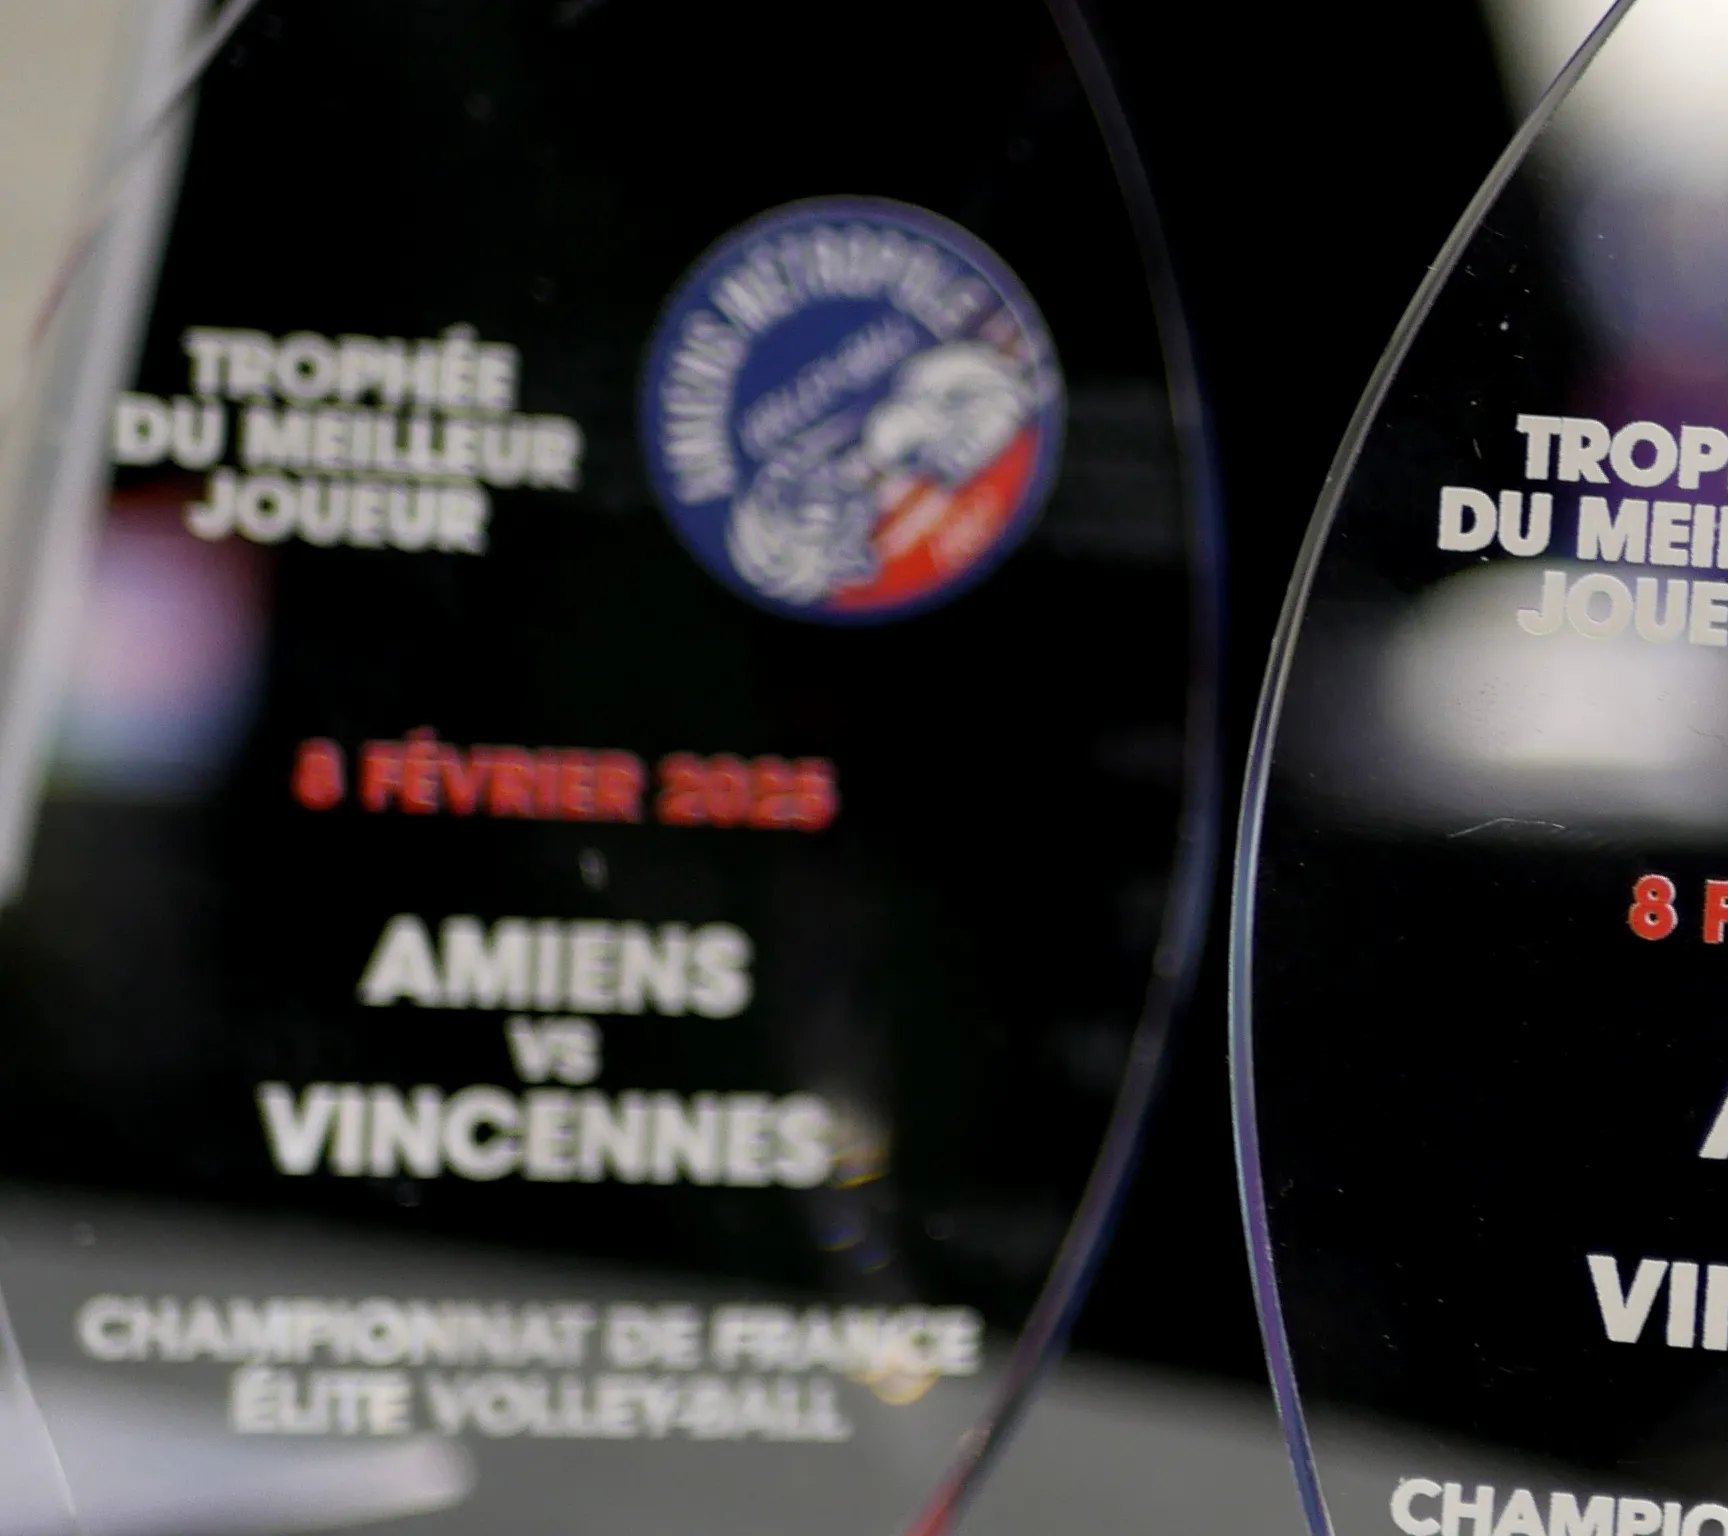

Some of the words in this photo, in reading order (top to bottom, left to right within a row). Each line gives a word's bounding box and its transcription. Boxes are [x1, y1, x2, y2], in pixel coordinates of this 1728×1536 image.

[182, 325, 520, 412] TROPHÉE
[114, 394, 227, 468] DU
[242, 406, 584, 489] MEILLEUR
[187, 472, 490, 554] JOUEUR
[1437, 486, 1554, 557] DU
[358, 726, 646, 822] FÉVRIER
[1628, 873, 1678, 941] 8
[357, 915, 755, 1017] AMIENS
[504, 1015, 604, 1085] VS
[255, 1082, 836, 1187] VINCENNES
[76, 1296, 602, 1366] CHAMPIONNAT
[608, 1304, 705, 1369] DE
[710, 1307, 984, 1374] FRANCE
[229, 1366, 415, 1435] ÉLITE
